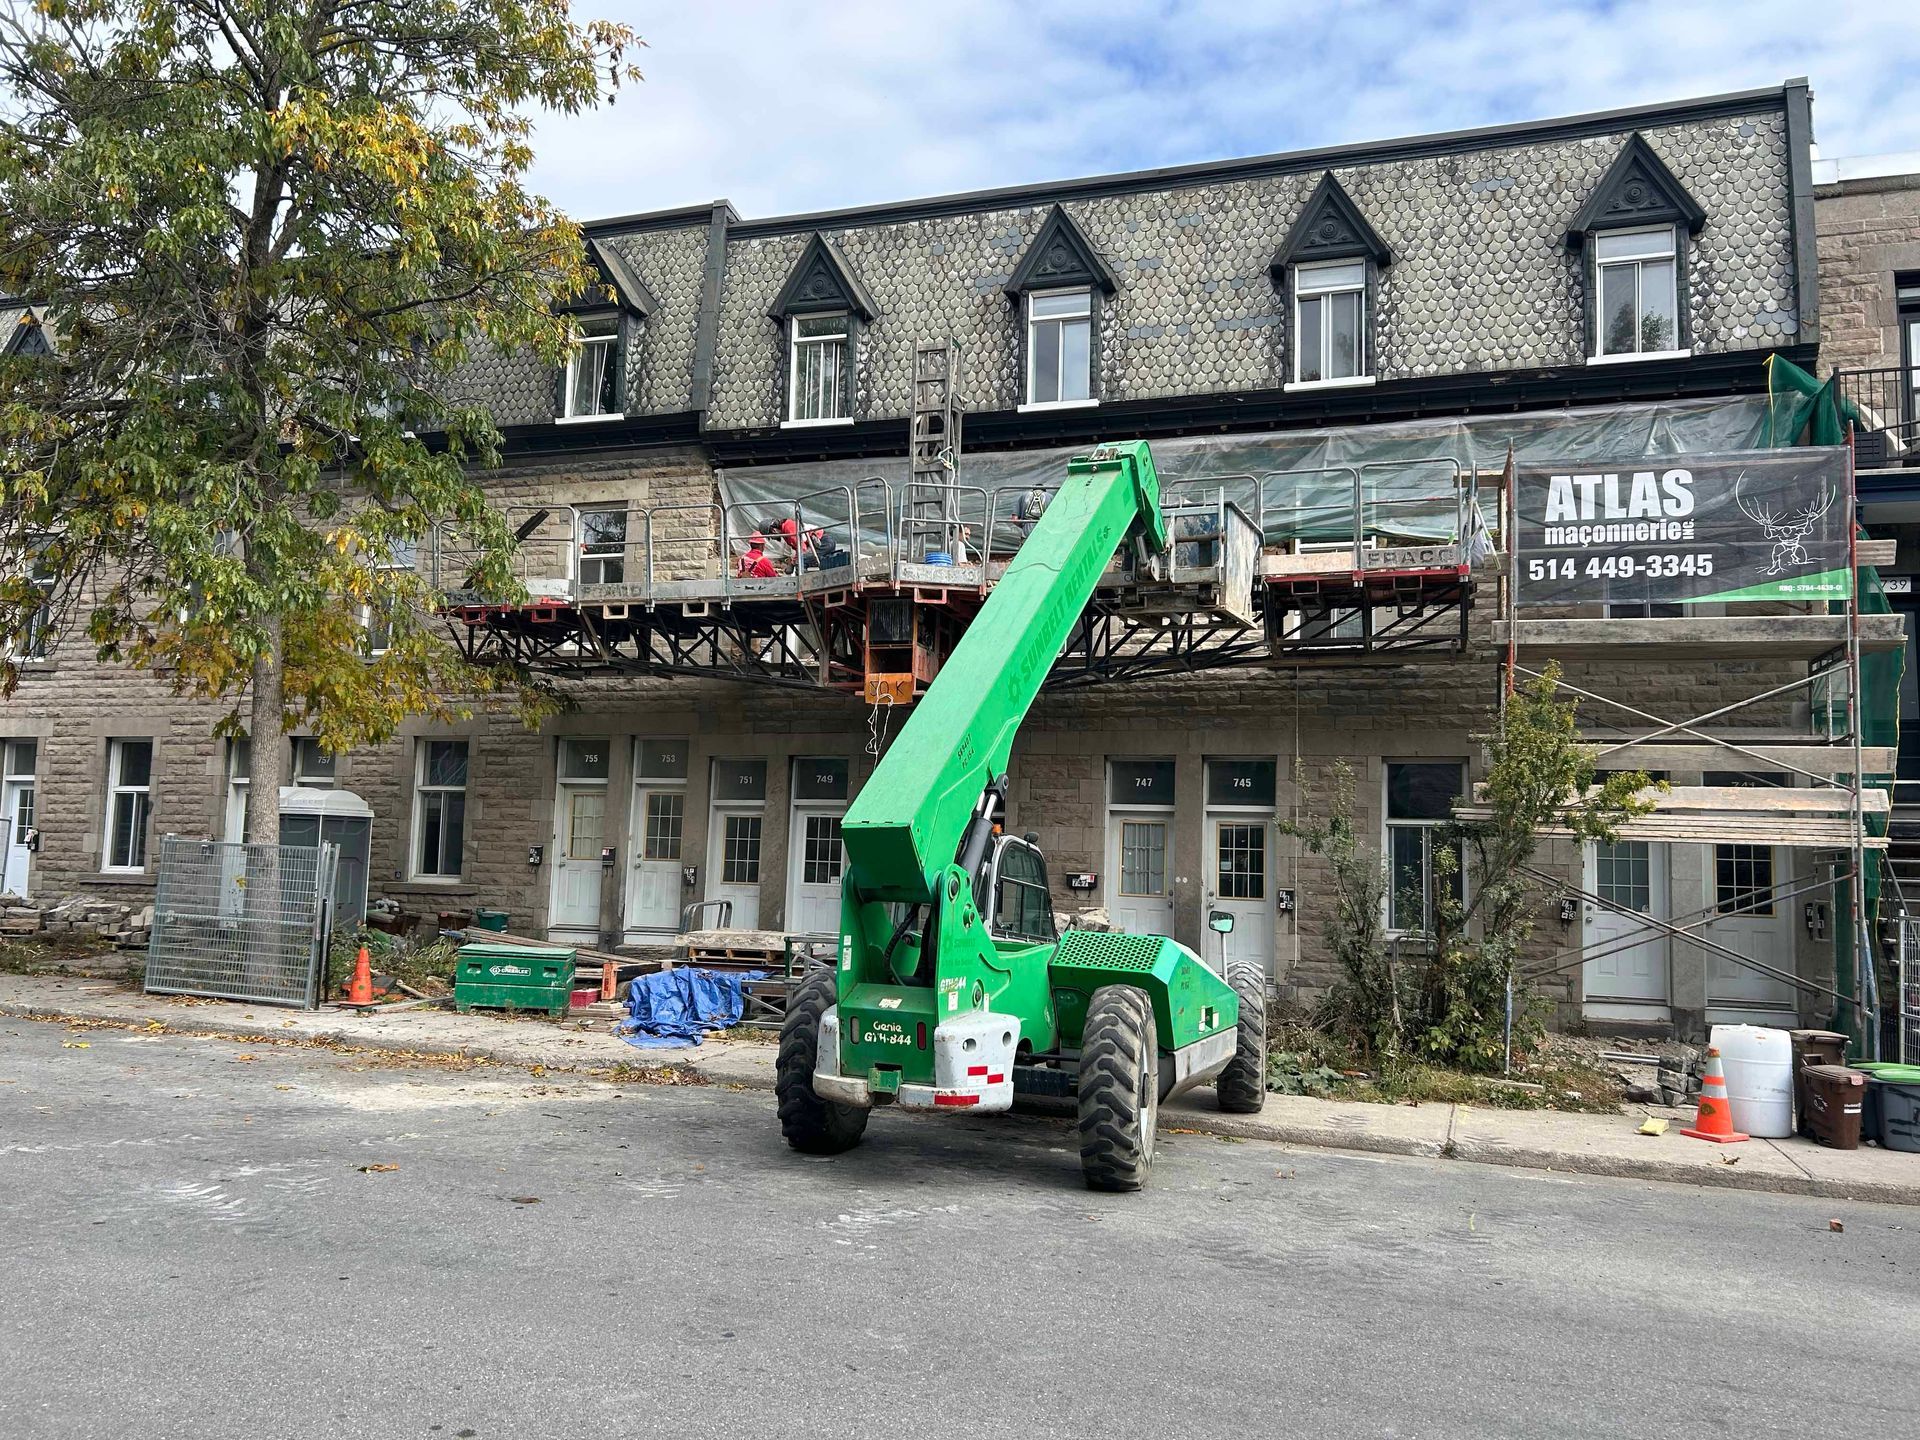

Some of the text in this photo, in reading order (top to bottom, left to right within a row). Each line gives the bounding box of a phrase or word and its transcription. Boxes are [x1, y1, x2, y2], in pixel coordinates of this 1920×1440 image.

[1545, 469, 1694, 522] ATLAS
[1545, 518, 1695, 548] maçonnerie INC.
[1529, 554, 1713, 581] 514 449-3345
[1021, 527, 1105, 684] SUNBELT RENTALS
[318, 756, 331, 764] 757
[585, 754, 599, 763] 755
[661, 754, 676, 763] 753
[739, 775, 753, 784] 751
[816, 774, 833, 784] 749
[1135, 778, 1152, 787] 747
[1233, 778, 1251, 787] 745
[873, 1021, 901, 1032] Genie
